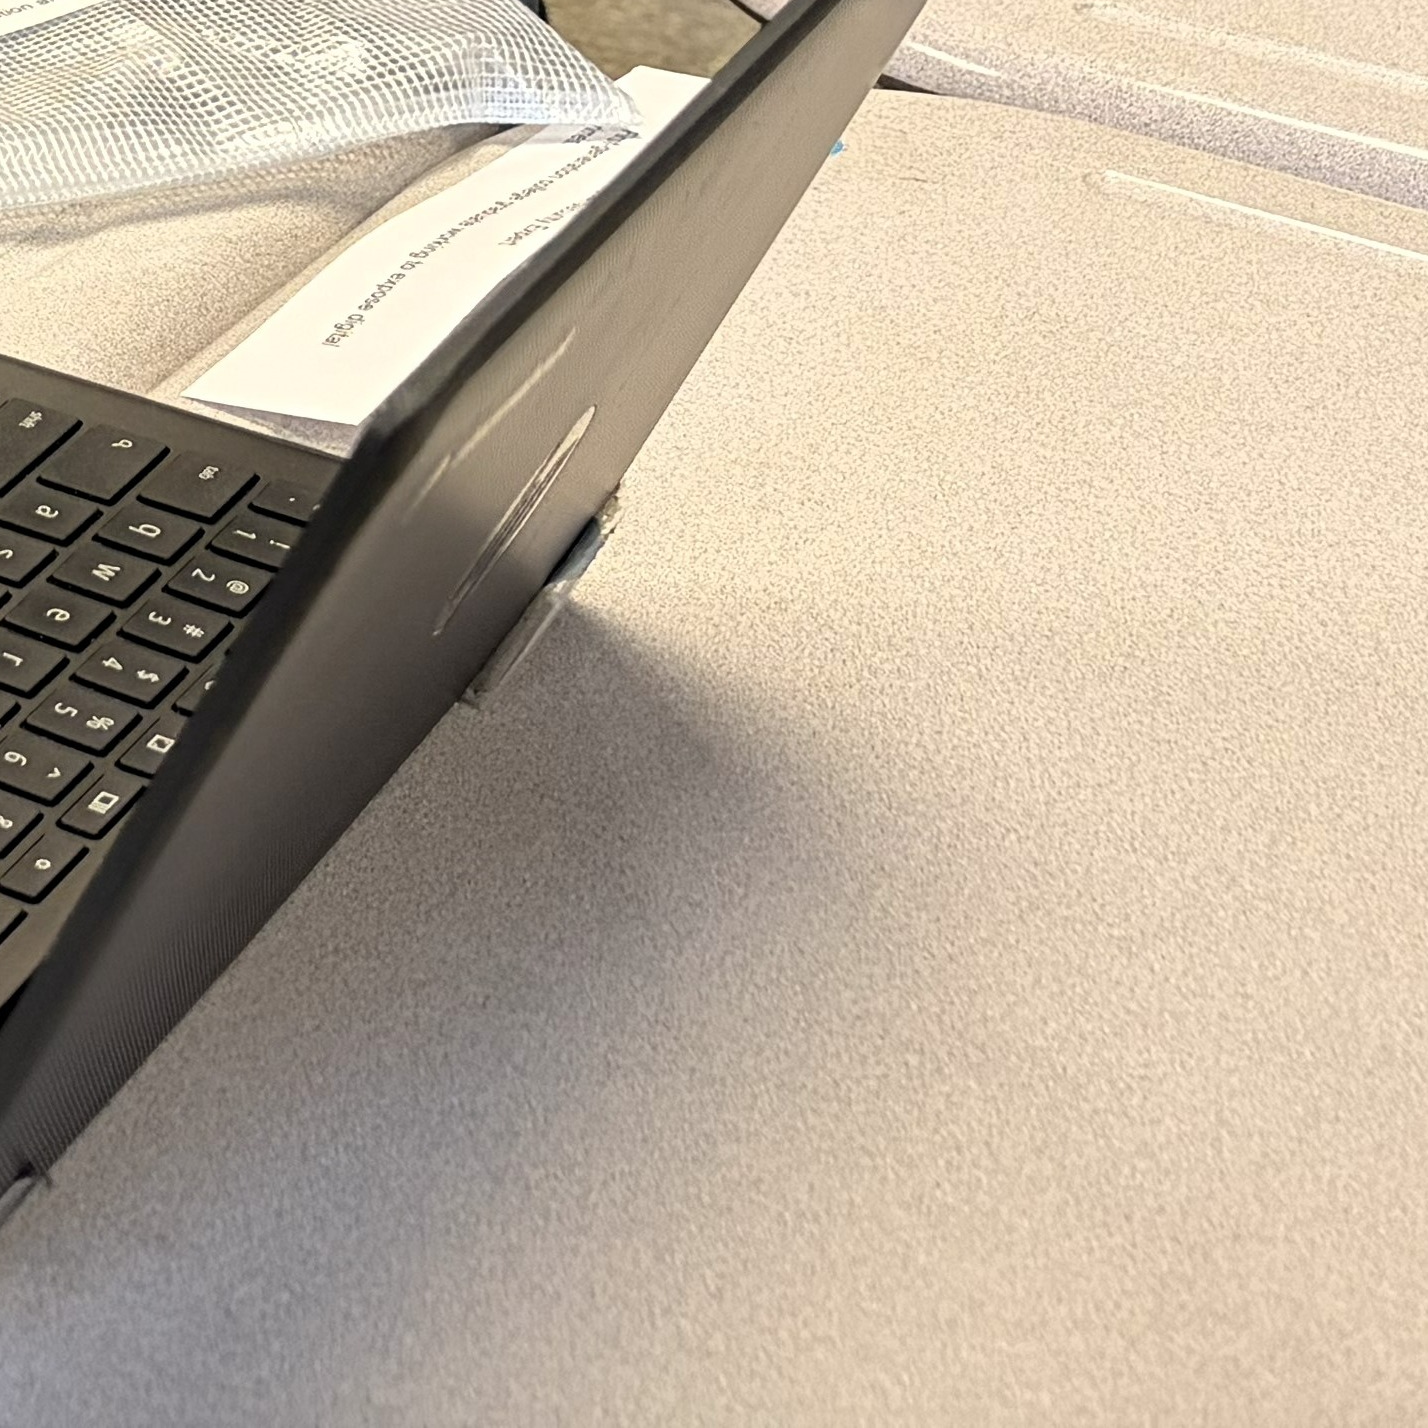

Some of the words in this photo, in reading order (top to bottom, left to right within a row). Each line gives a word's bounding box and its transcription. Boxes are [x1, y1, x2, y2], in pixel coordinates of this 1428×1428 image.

[400, 259, 424, 273] to
[358, 272, 406, 312] expose
[322, 312, 364, 348] digital
[18, 411, 42, 429] shift
[35, 505, 59, 518] a
[128, 523, 161, 538] q
[92, 563, 121, 581] w
[191, 568, 216, 582] 2
[226, 580, 249, 595] @
[46, 608, 71, 622] e
[148, 611, 172, 626] 3
[183, 624, 205, 638] #
[2, 652, 23, 667] r
[102, 657, 123, 671] 4
[136, 669, 160, 683] $
[54, 702, 78, 717] 5
[86, 715, 115, 730] %
[4, 751, 27, 766] 6
